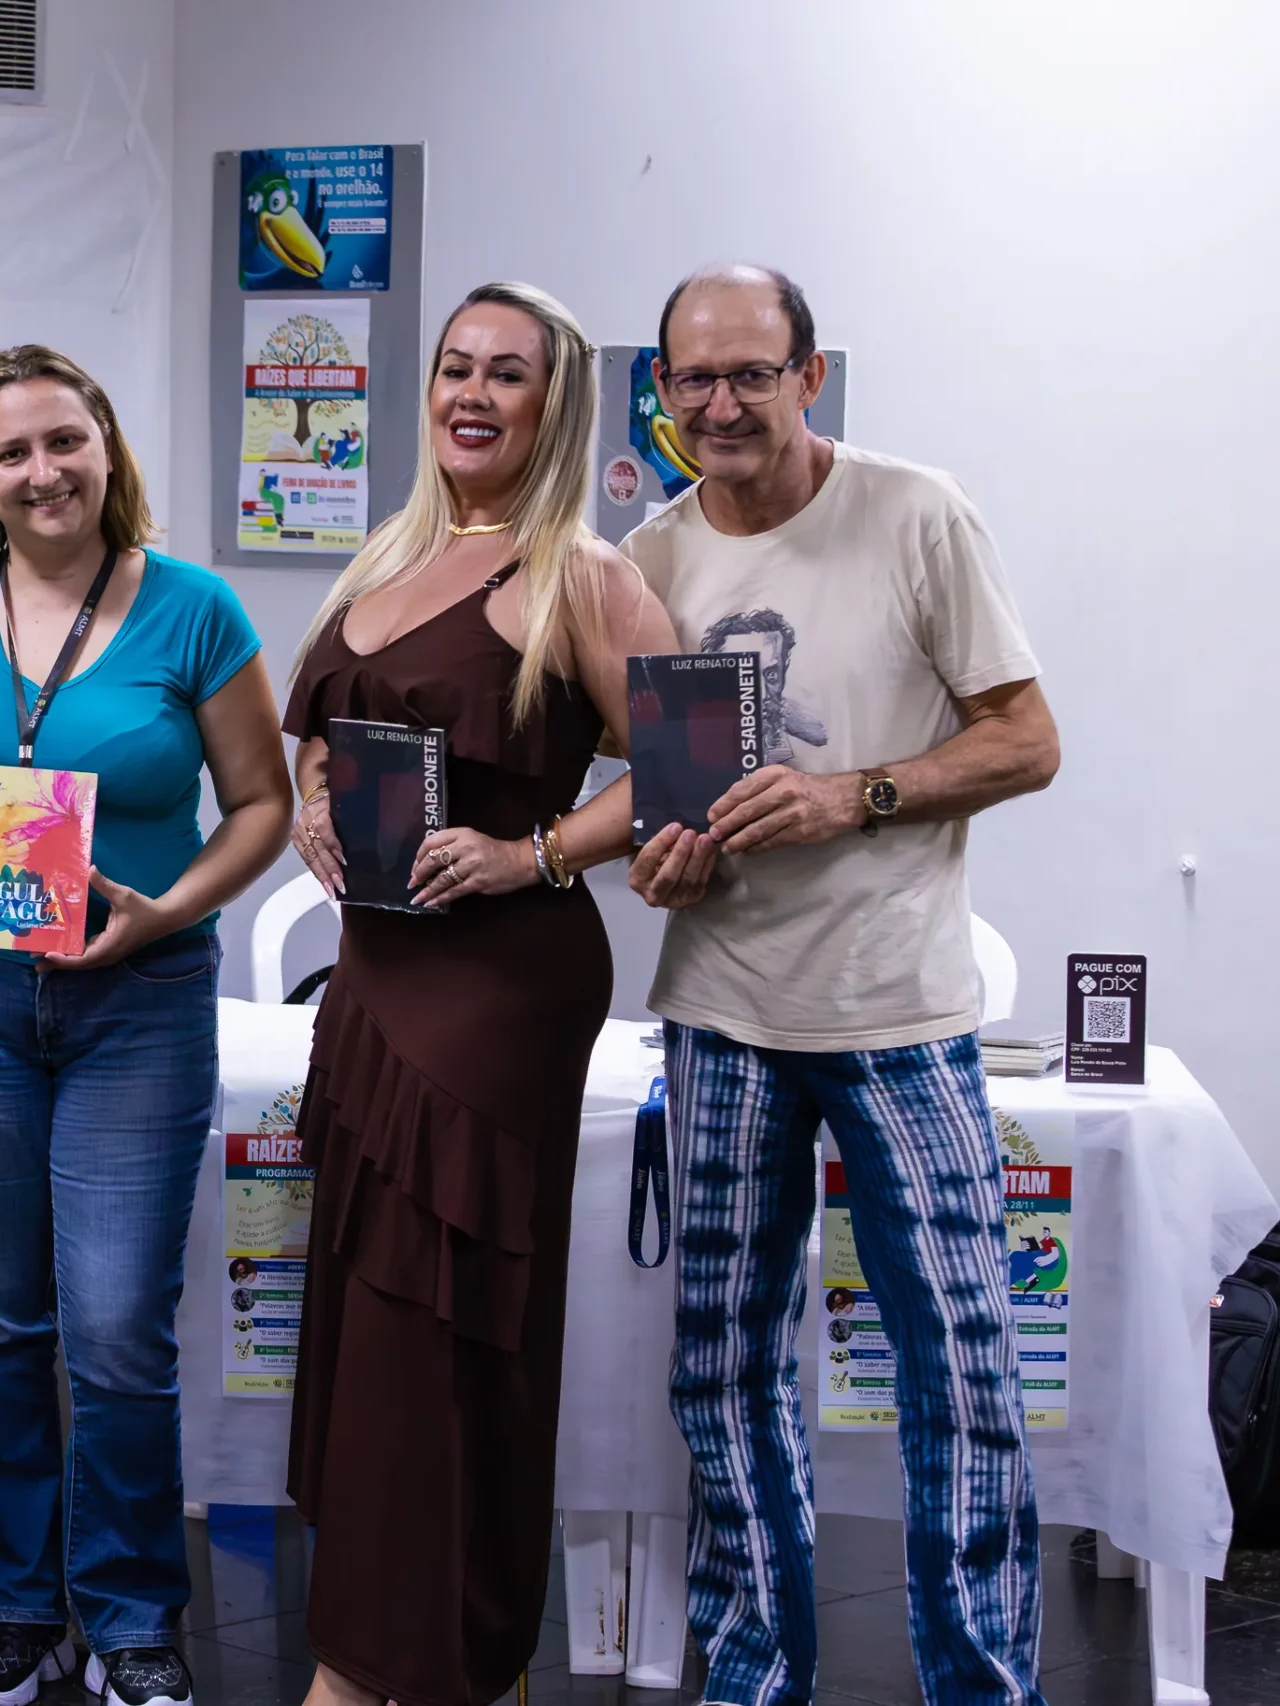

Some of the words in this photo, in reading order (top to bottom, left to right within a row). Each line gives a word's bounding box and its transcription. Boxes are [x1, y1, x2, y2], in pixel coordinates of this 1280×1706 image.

[350, 151, 356, 159] o
[358, 148, 384, 159] Brasil
[335, 165, 355, 177] use
[358, 165, 366, 177] o
[370, 162, 383, 176] 14
[318, 184, 333, 195] no
[336, 179, 383, 194] orelhão.
[255, 366, 286, 386] RAÍZES
[288, 369, 306, 387] QUE
[308, 369, 356, 387] LIBERTAM
[74, 614, 90, 637] ALMT
[671, 659, 692, 670] LUIZ
[695, 657, 736, 669] RENATO
[739, 656, 757, 751] SABONETE
[367, 729, 385, 740] LUIZ
[386, 731, 422, 744] RENATO
[742, 755, 757, 769] O
[424, 735, 439, 826] SABONETE
[16, 921, 39, 930] Luciene
[39, 923, 66, 931] Carvalho
[1075, 963, 1113, 973] PAGUE
[1115, 964, 1142, 974] COM
[1100, 975, 1138, 996] pix
[256, 1168, 316, 1180] PROGRAMAÇ
[236, 1204, 247, 1213] Ler
[253, 1205, 265, 1214] um
[266, 1199, 278, 1207] ato
[1010, 1201, 1034, 1210] 28/11
[253, 1220, 265, 1228] um
[234, 1238, 253, 1247] novas
[1027, 1413, 1046, 1421] ALMT
